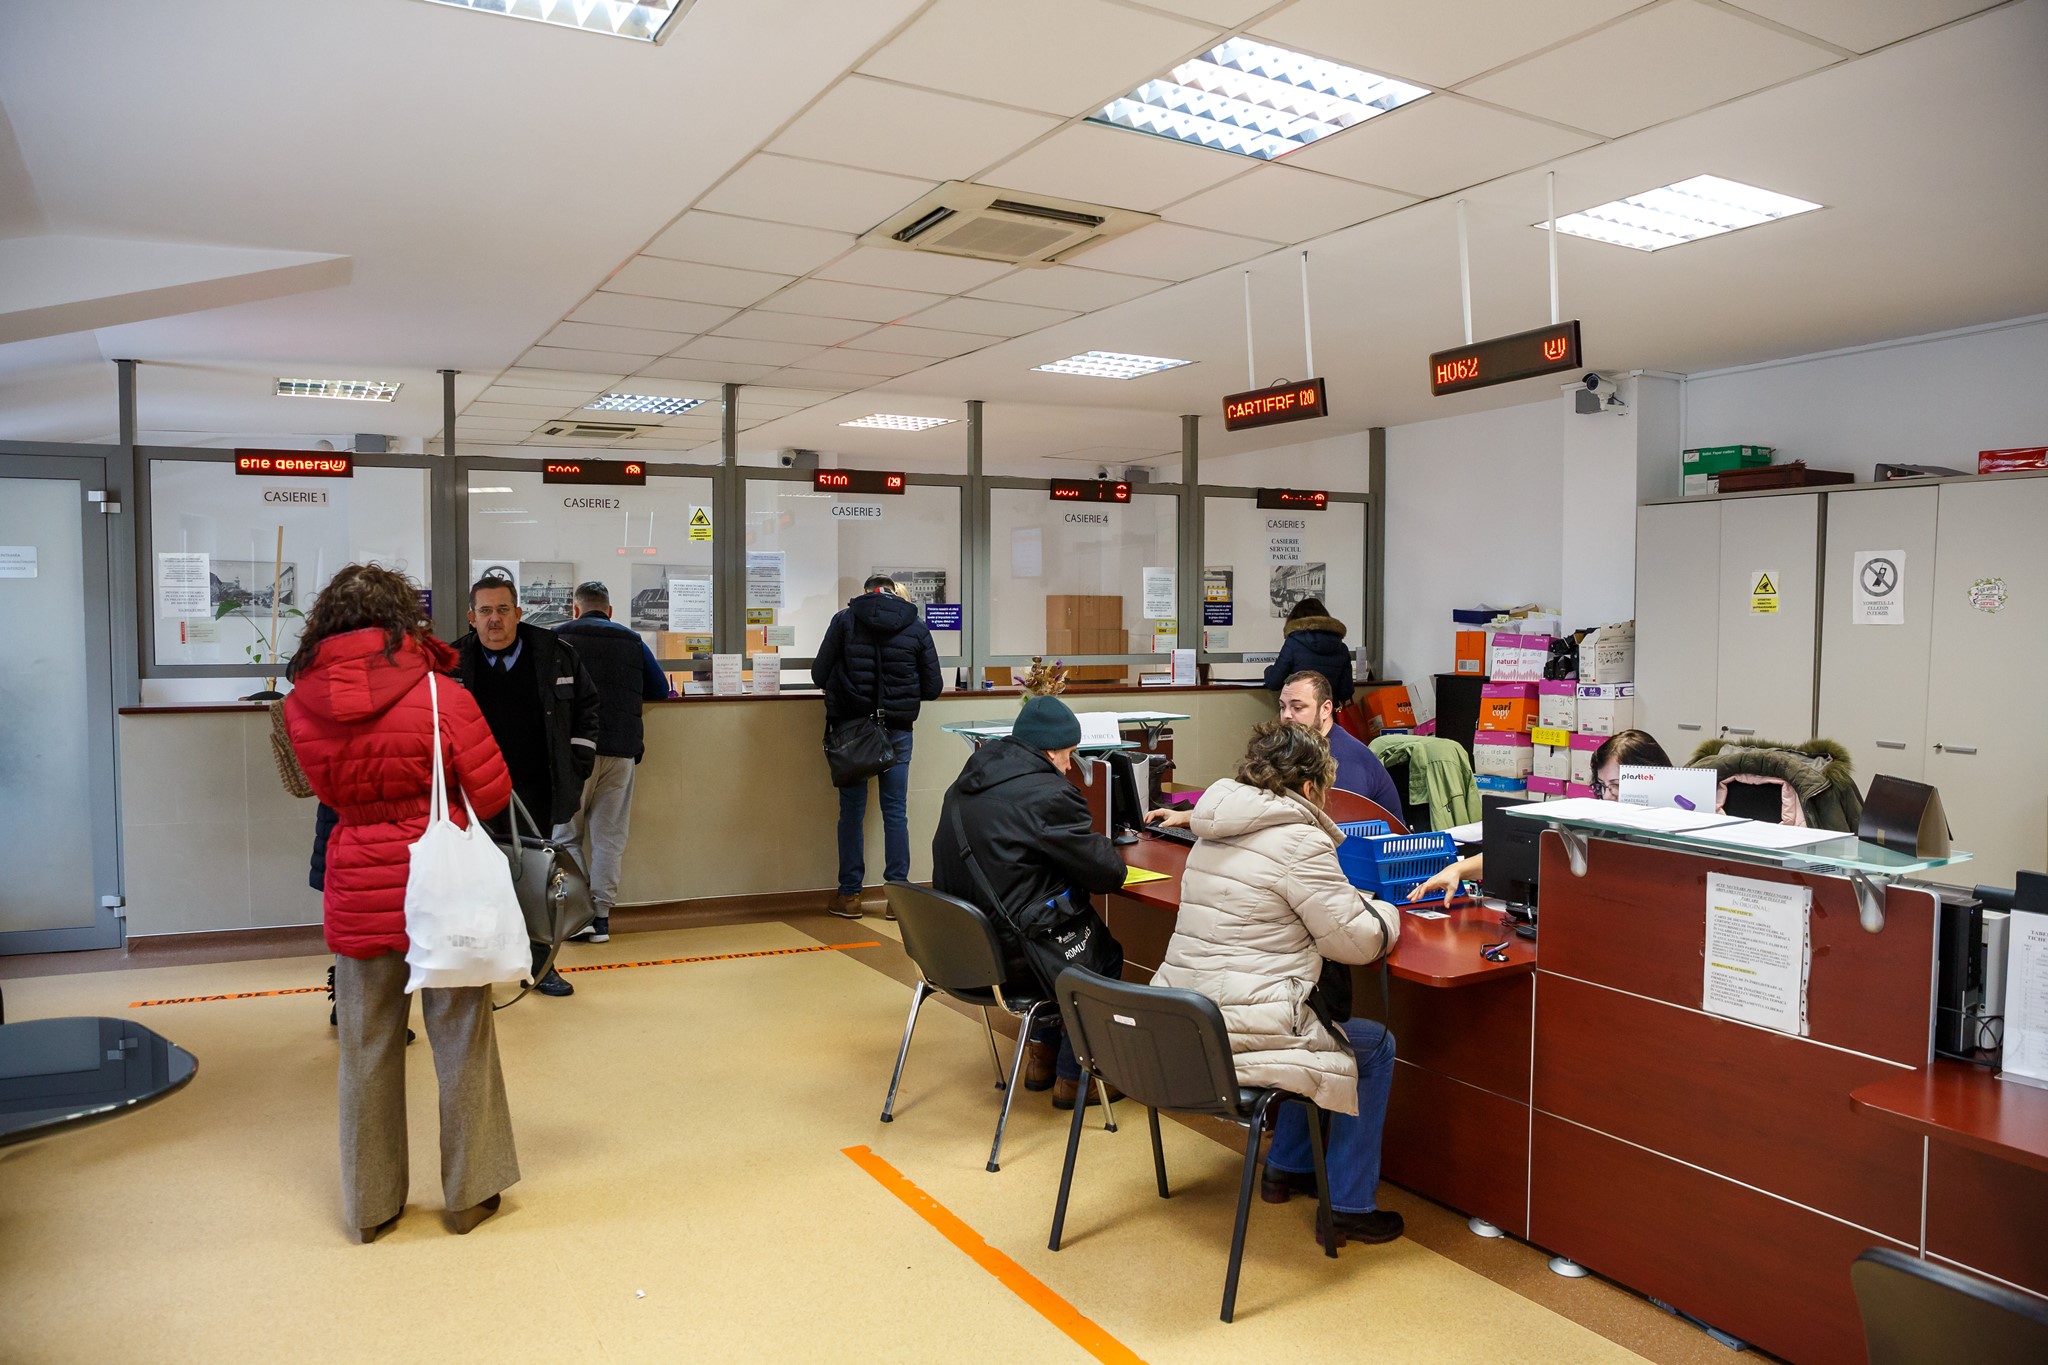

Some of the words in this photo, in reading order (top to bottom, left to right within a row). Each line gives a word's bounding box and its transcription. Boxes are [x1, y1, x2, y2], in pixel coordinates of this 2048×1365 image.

[1437, 358, 1478, 384] H062
[264, 492, 318, 502] CASIERIE
[321, 493, 326, 502] 1
[564, 498, 610, 508] CASIERIE
[614, 500, 619, 508] 2
[832, 506, 873, 516] CASIERIE
[876, 508, 881, 516] 3
[1065, 514, 1101, 523] CASIERIE
[1268, 520, 1299, 528] CASIERIE
[1492, 702, 1512, 710] vari
[1492, 710, 1510, 719] copy
[558, 964, 629, 972] LIMITA
[140, 995, 227, 1006] LIMITA
[278, 986, 331, 995] CON
